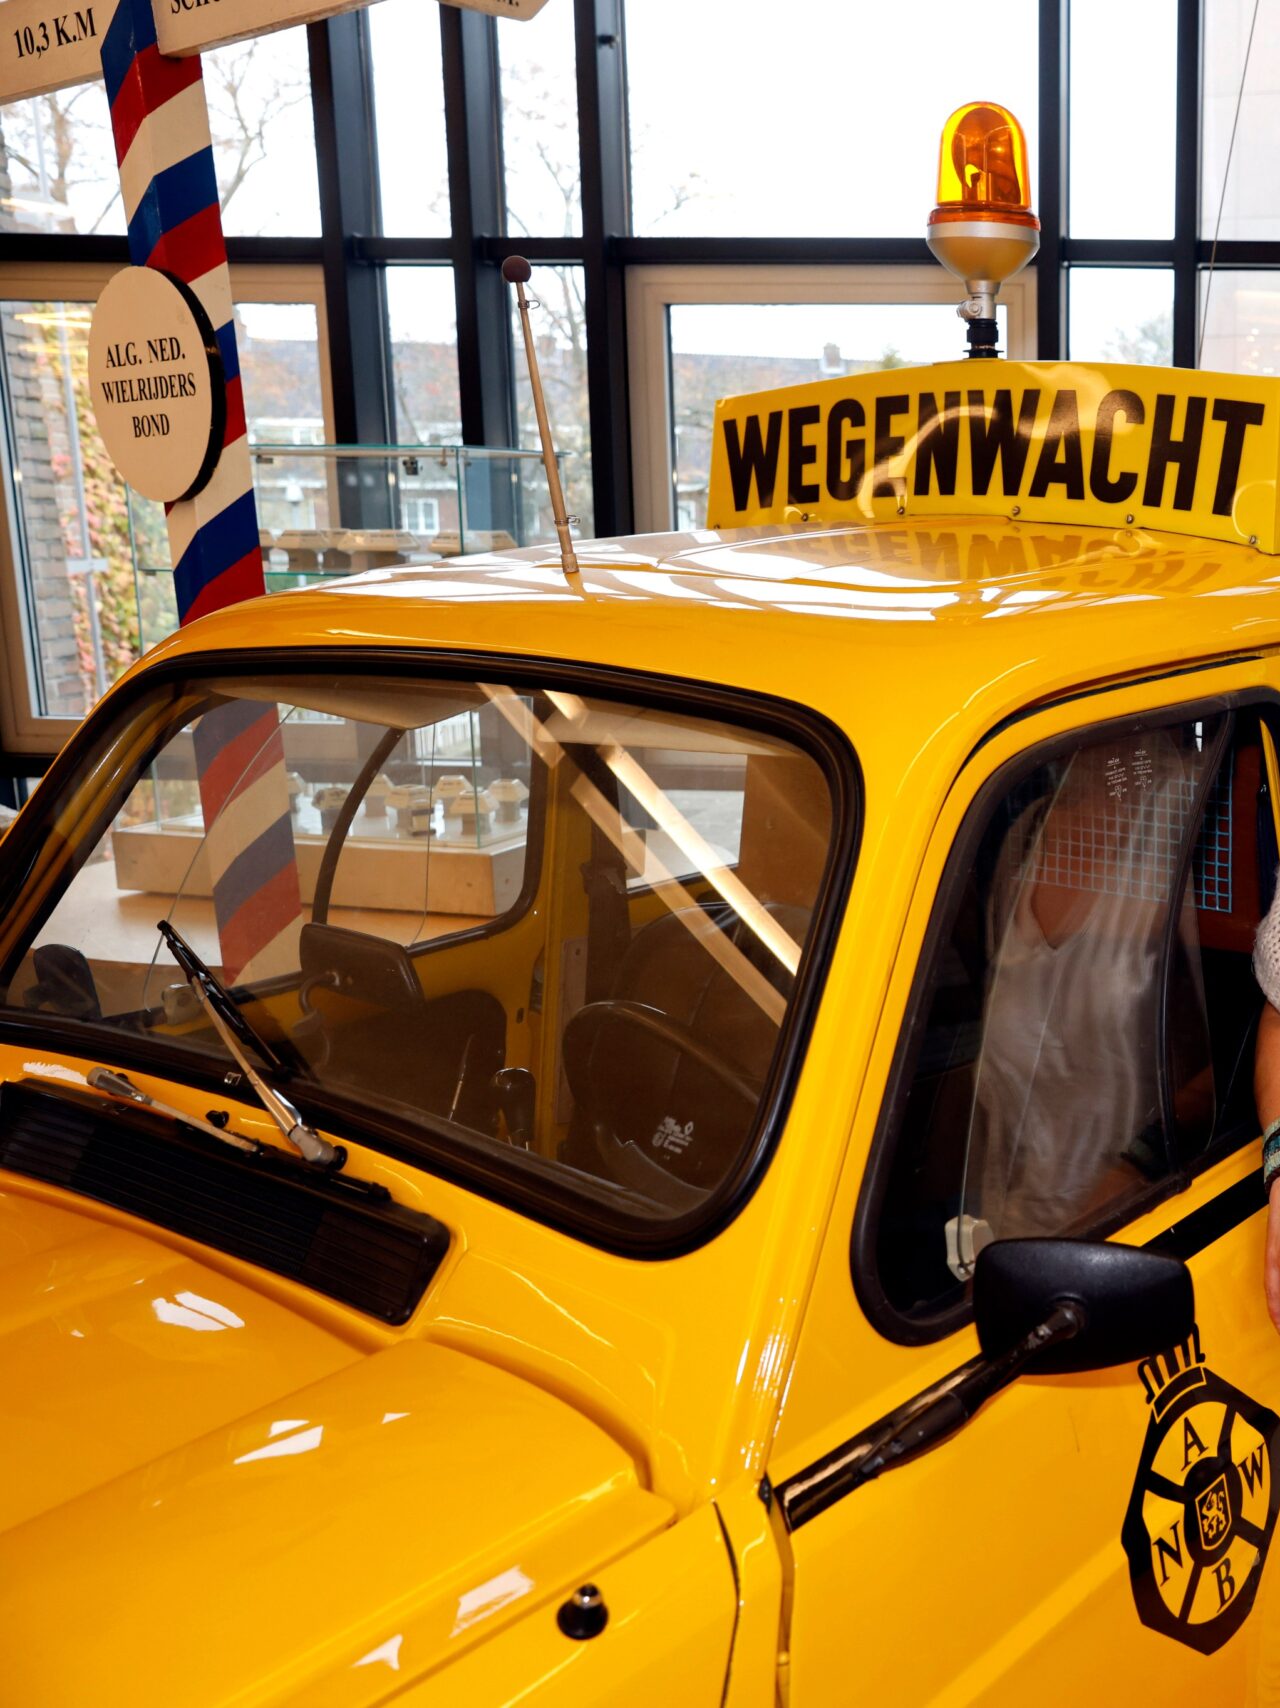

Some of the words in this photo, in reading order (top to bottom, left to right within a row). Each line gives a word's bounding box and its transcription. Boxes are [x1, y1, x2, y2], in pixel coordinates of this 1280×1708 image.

[13, 22, 51, 59] 10,3
[52, 7, 98, 47] K.M
[105, 341, 142, 368] ALG.
[146, 336, 186, 363] NED.
[101, 372, 197, 404] WIELRIJDERS
[132, 413, 170, 438] BOND
[723, 389, 1265, 517] WEGENWACHT
